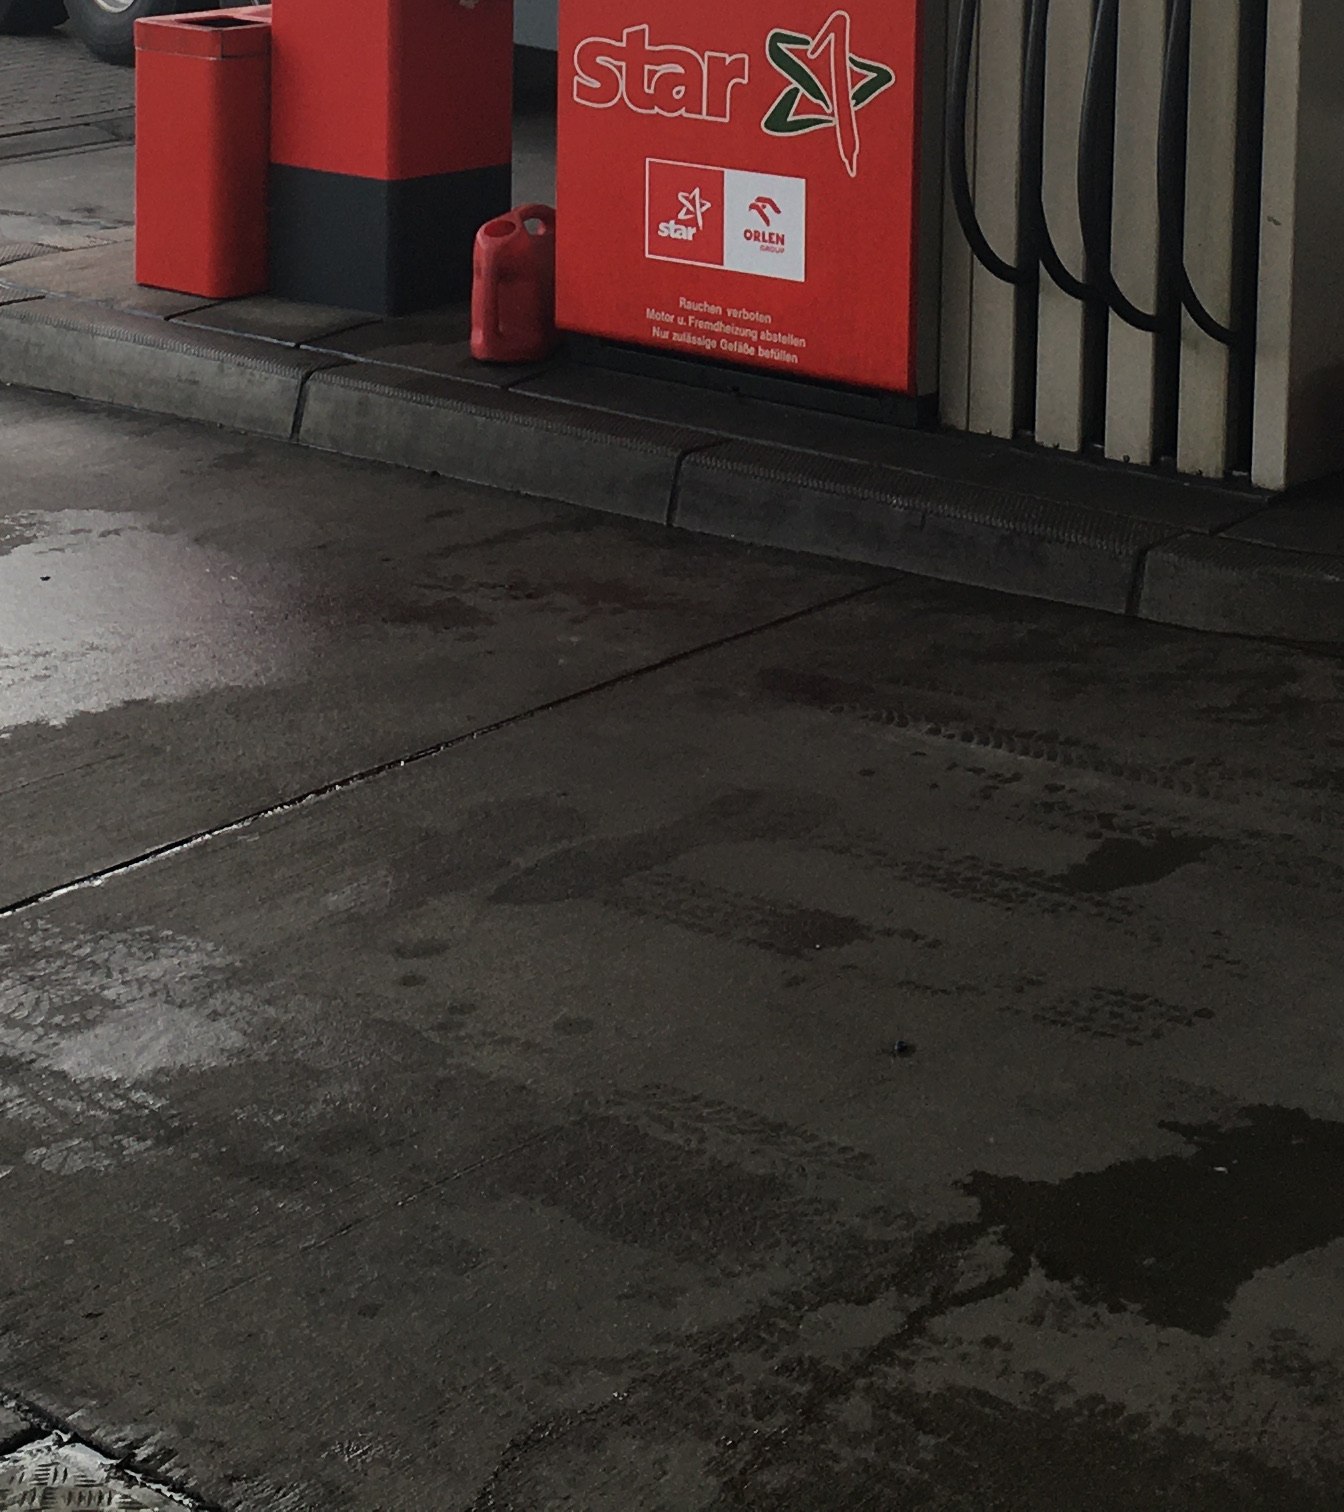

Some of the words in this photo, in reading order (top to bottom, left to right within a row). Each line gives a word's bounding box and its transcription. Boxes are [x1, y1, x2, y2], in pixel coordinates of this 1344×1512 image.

[573, 24, 749, 123] star
[658, 219, 697, 241] star
[743, 228, 785, 246] ORLEN
[759, 244, 785, 254] GROUP
[679, 296, 723, 316] Rauchen
[726, 307, 772, 324] verboten
[646, 308, 675, 324] Motor
[677, 316, 687, 326] u.
[688, 315, 758, 341] Fremdheizung
[760, 329, 807, 348] abstellen
[652, 326, 670, 340] Nur
[672, 332, 717, 350] zulässige
[720, 338, 755, 356] Gefäße
[758, 345, 799, 364] befüllen
